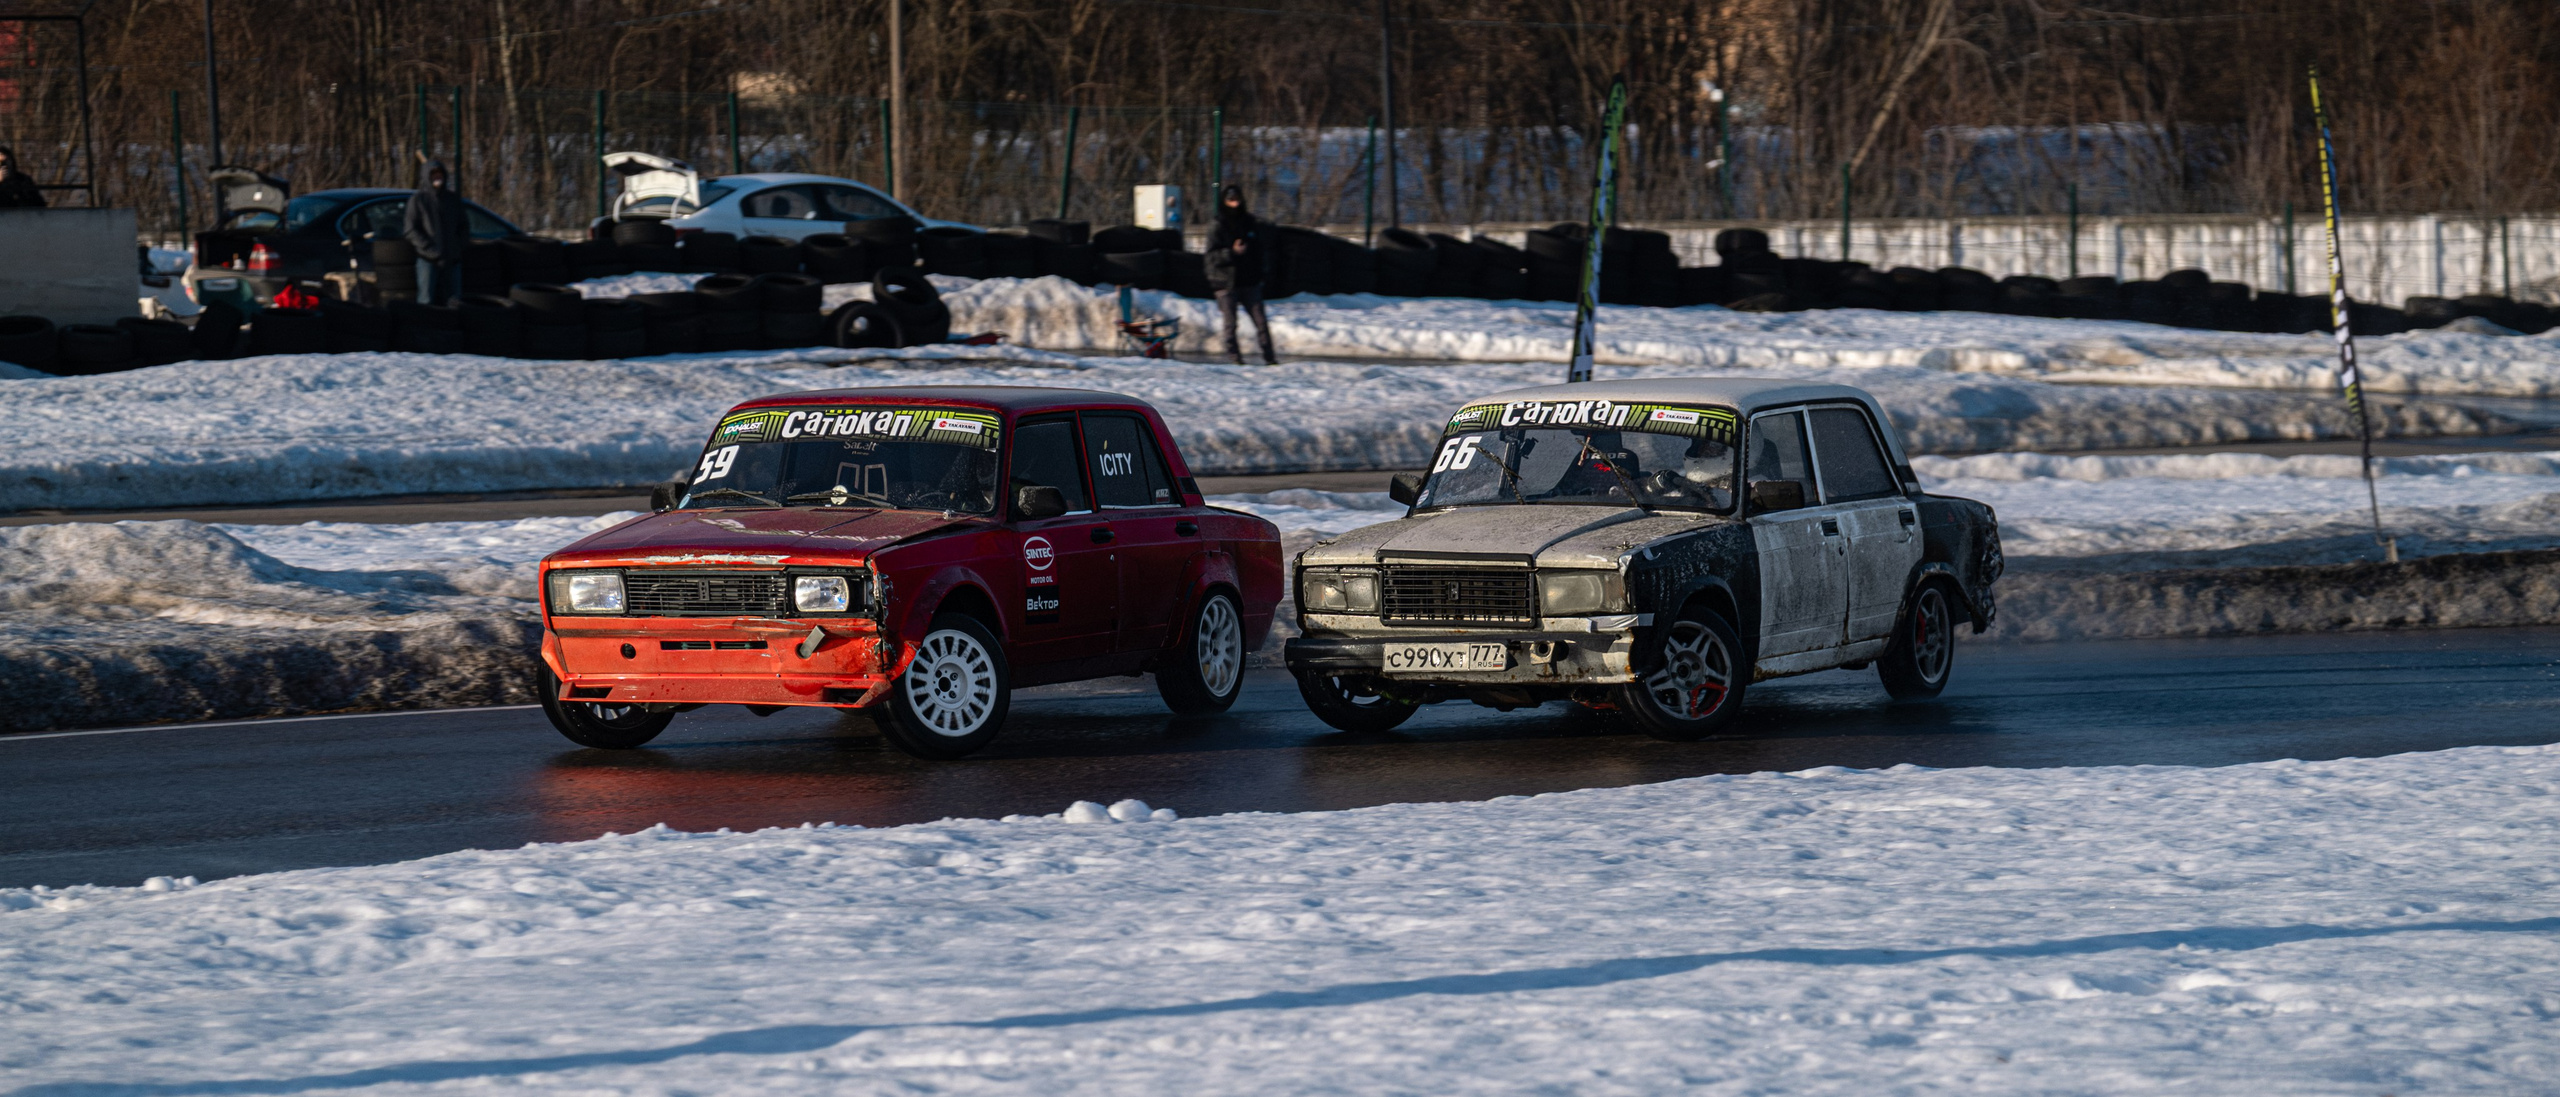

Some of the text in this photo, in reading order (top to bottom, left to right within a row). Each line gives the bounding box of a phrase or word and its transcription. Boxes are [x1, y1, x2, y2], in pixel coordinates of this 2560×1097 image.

[724, 421, 764, 434] EXHAUST
[1100, 452, 1132, 476] ICITY
[1433, 435, 1482, 474] 66
[693, 445, 740, 485] 59
[1025, 547, 1053, 559] SINTEC
[1471, 645, 1500, 661] 777
